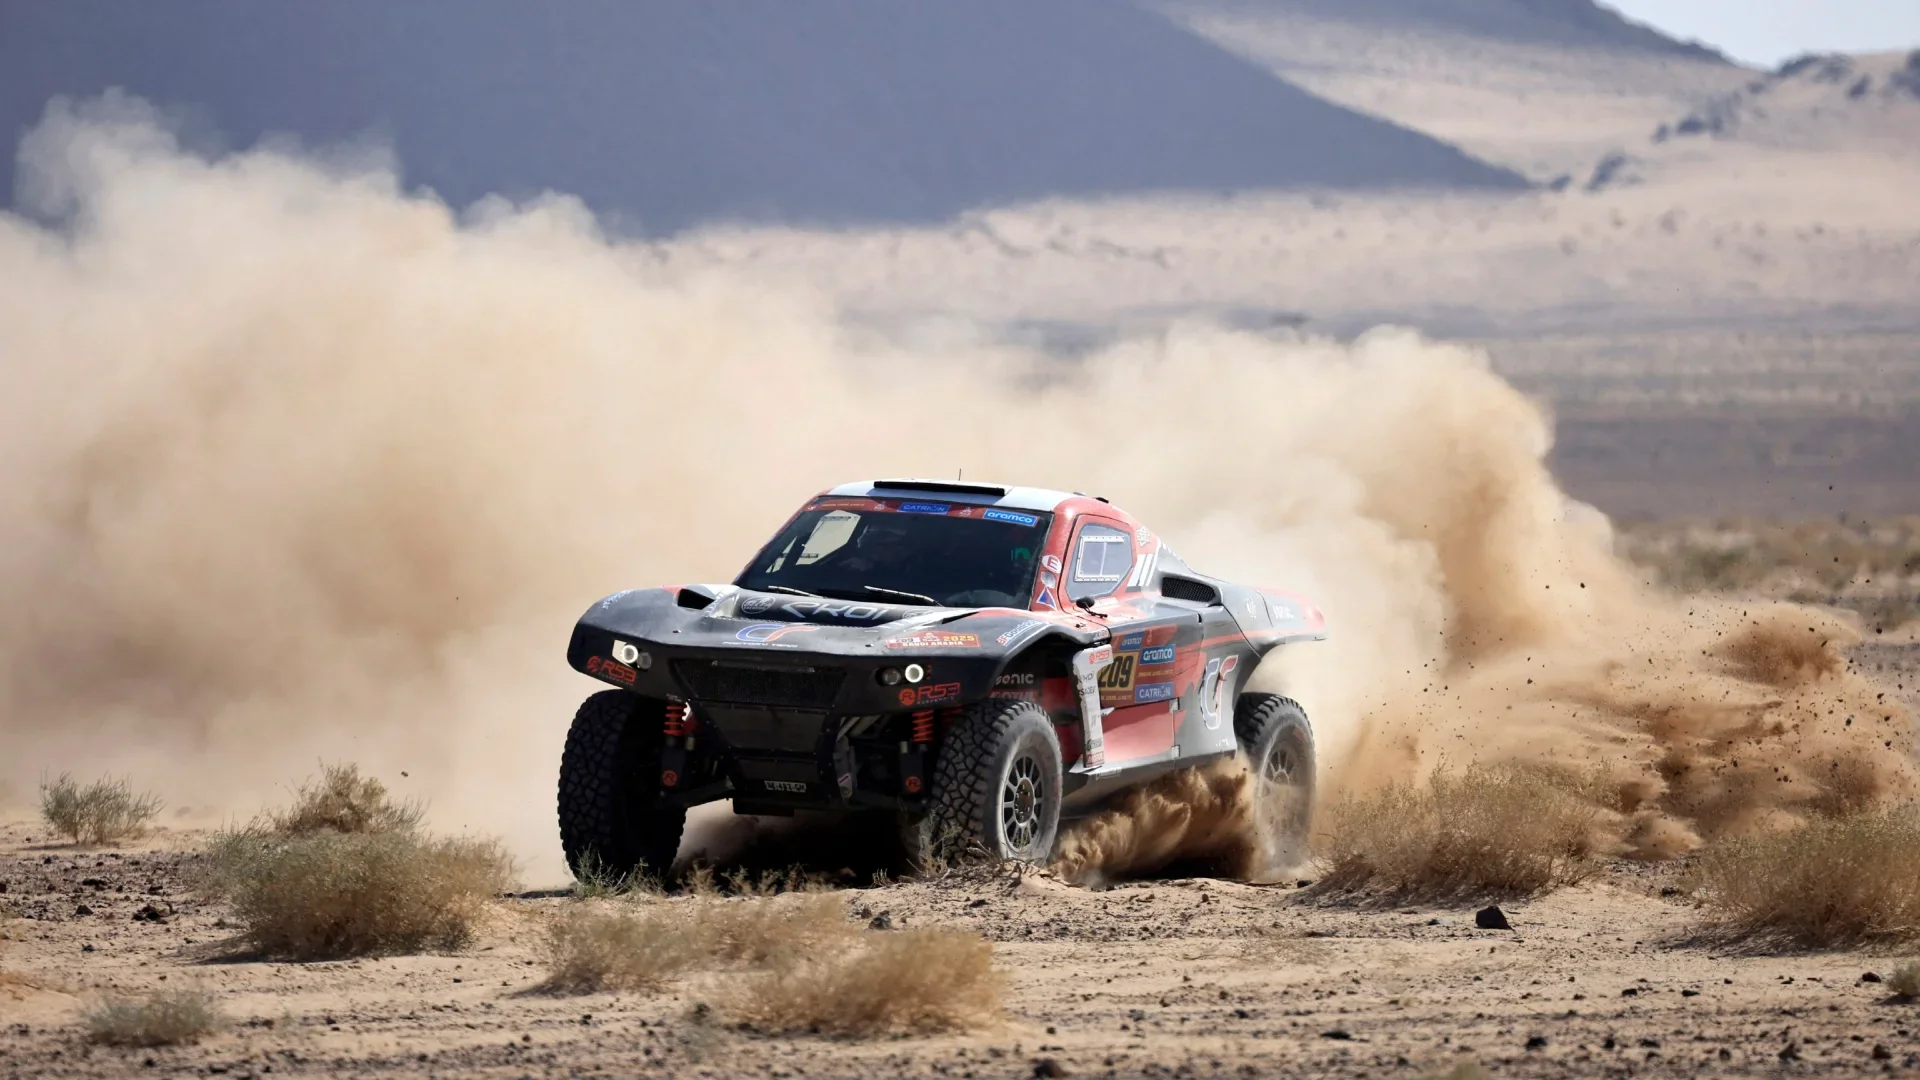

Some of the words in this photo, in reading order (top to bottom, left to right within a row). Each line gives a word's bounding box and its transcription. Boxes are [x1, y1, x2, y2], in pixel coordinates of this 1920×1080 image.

[986, 511, 1033, 524] aramco
[1142, 647, 1173, 661] aramco
[602, 659, 637, 683] RS3
[1097, 655, 1134, 689] 209
[917, 682, 960, 701] RS3
